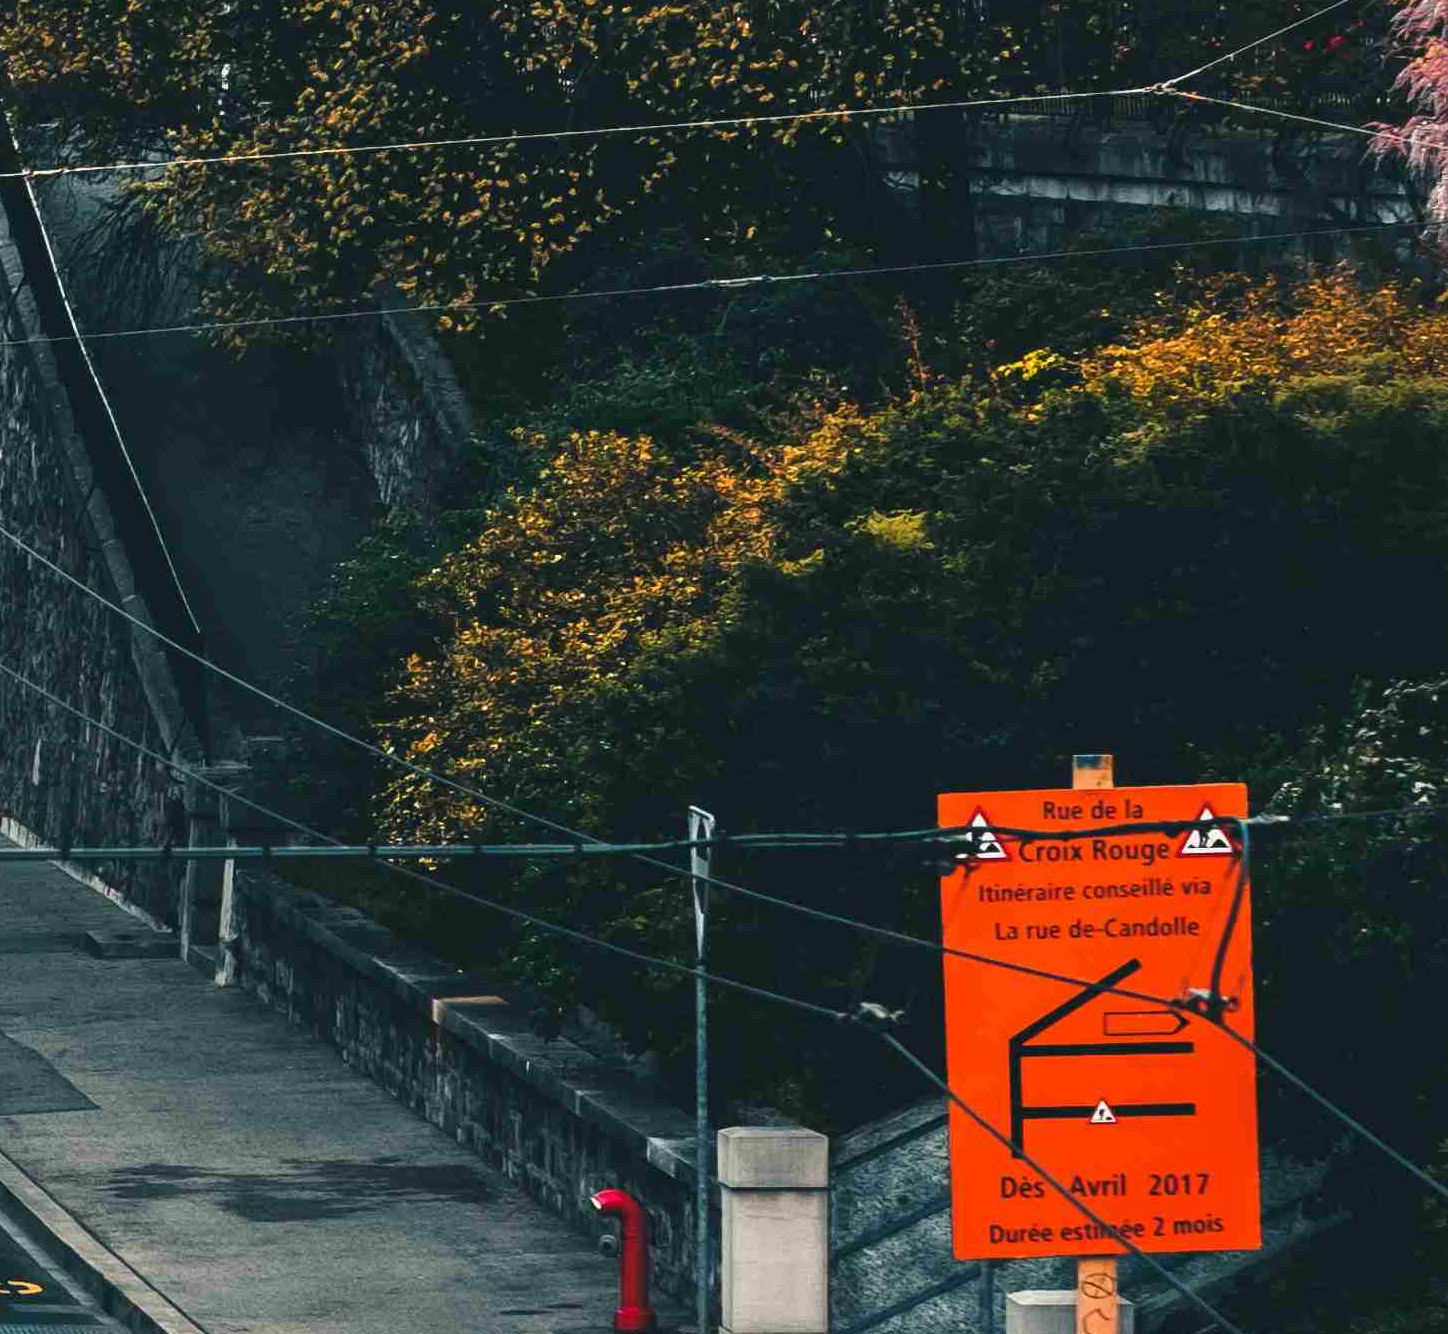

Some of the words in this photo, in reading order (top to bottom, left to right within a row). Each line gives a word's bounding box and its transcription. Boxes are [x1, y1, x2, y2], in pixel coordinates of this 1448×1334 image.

[1042, 801, 1083, 820] Rue
[1091, 800, 1118, 820] de
[1125, 799, 1144, 819] la
[1018, 840, 1084, 863] Croix
[1092, 839, 1171, 866] Rouge
[979, 882, 1076, 903] Itinéraire
[1082, 878, 1174, 900] conseillé
[1181, 879, 1212, 896] via
[994, 922, 1019, 941] La
[1026, 924, 1061, 939] rue
[1000, 1176, 1045, 1199] Dès
[1070, 1173, 1127, 1197] Avril
[1148, 1173, 1210, 1197] 2017
[989, 1223, 1054, 1244] Durée
[1153, 1217, 1166, 1236] 2
[1173, 1214, 1224, 1235] mois
